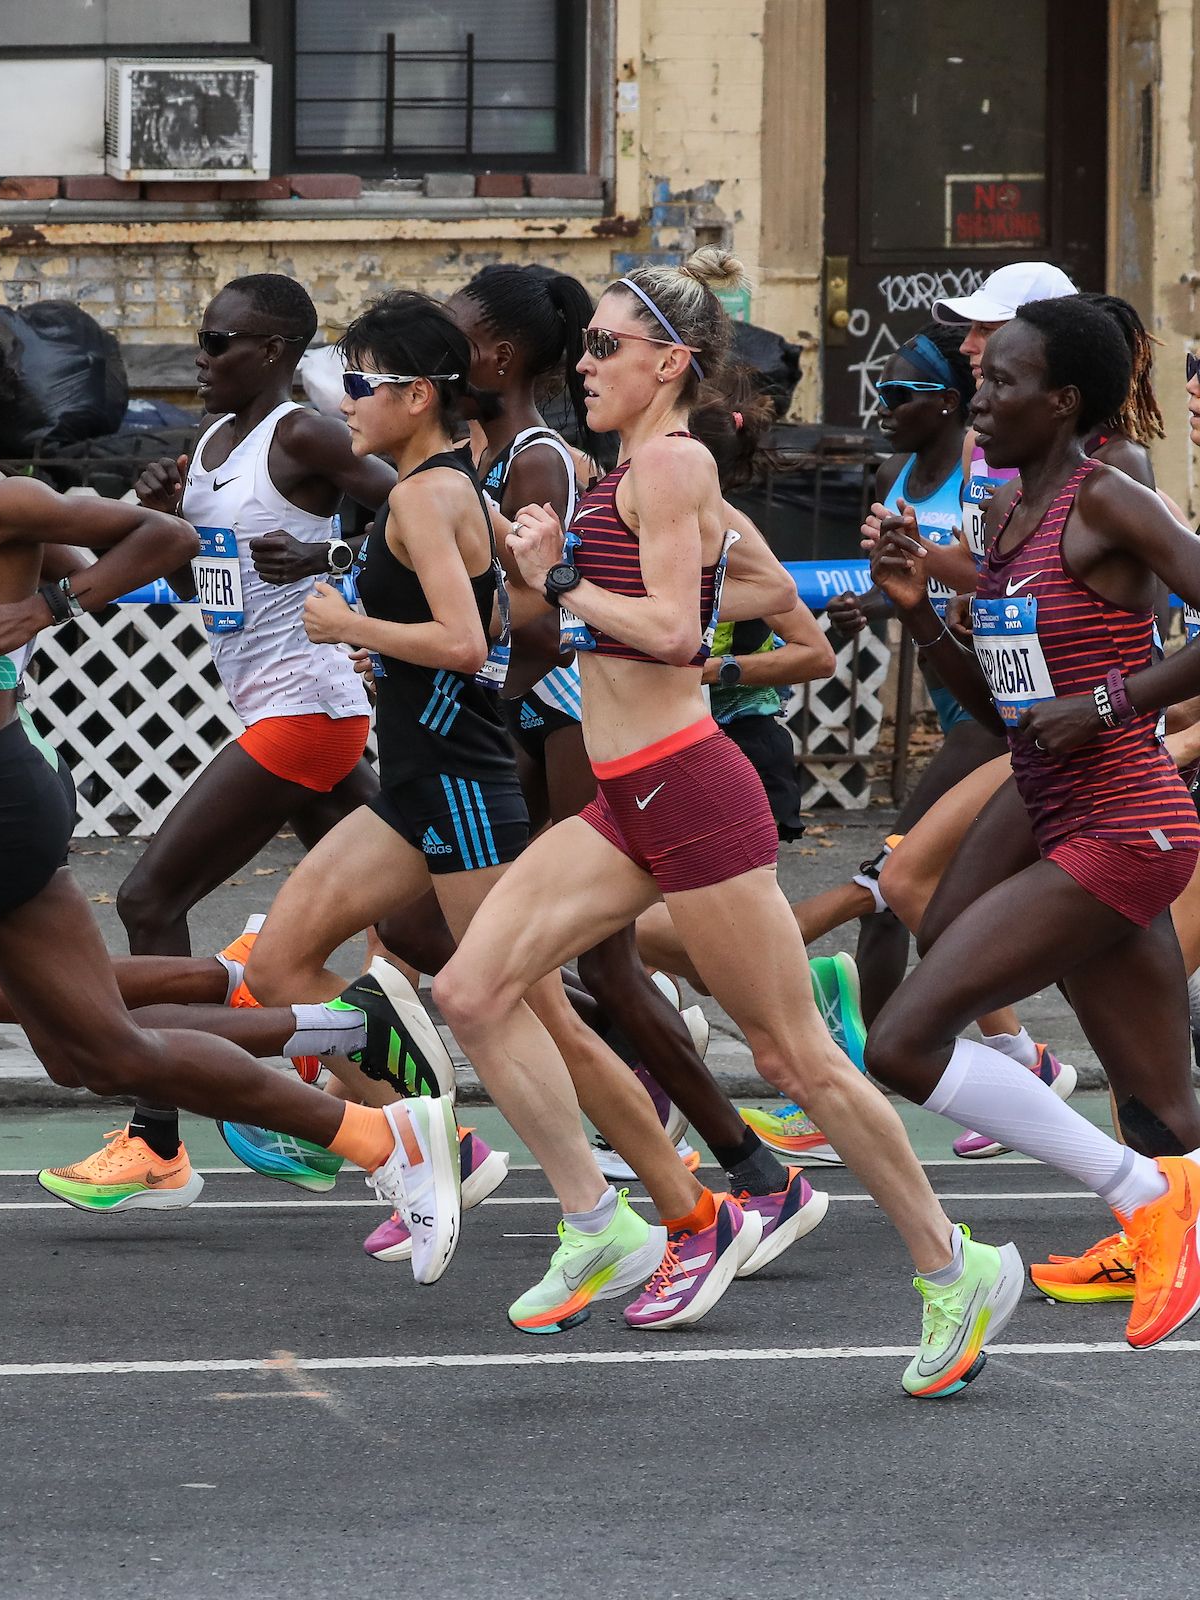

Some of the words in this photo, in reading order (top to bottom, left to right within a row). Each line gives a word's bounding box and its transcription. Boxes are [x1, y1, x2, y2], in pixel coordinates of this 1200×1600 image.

[975, 184, 1020, 210] NO
[1004, 620, 1022, 629] TATA
[520, 716, 545, 730] adidas
